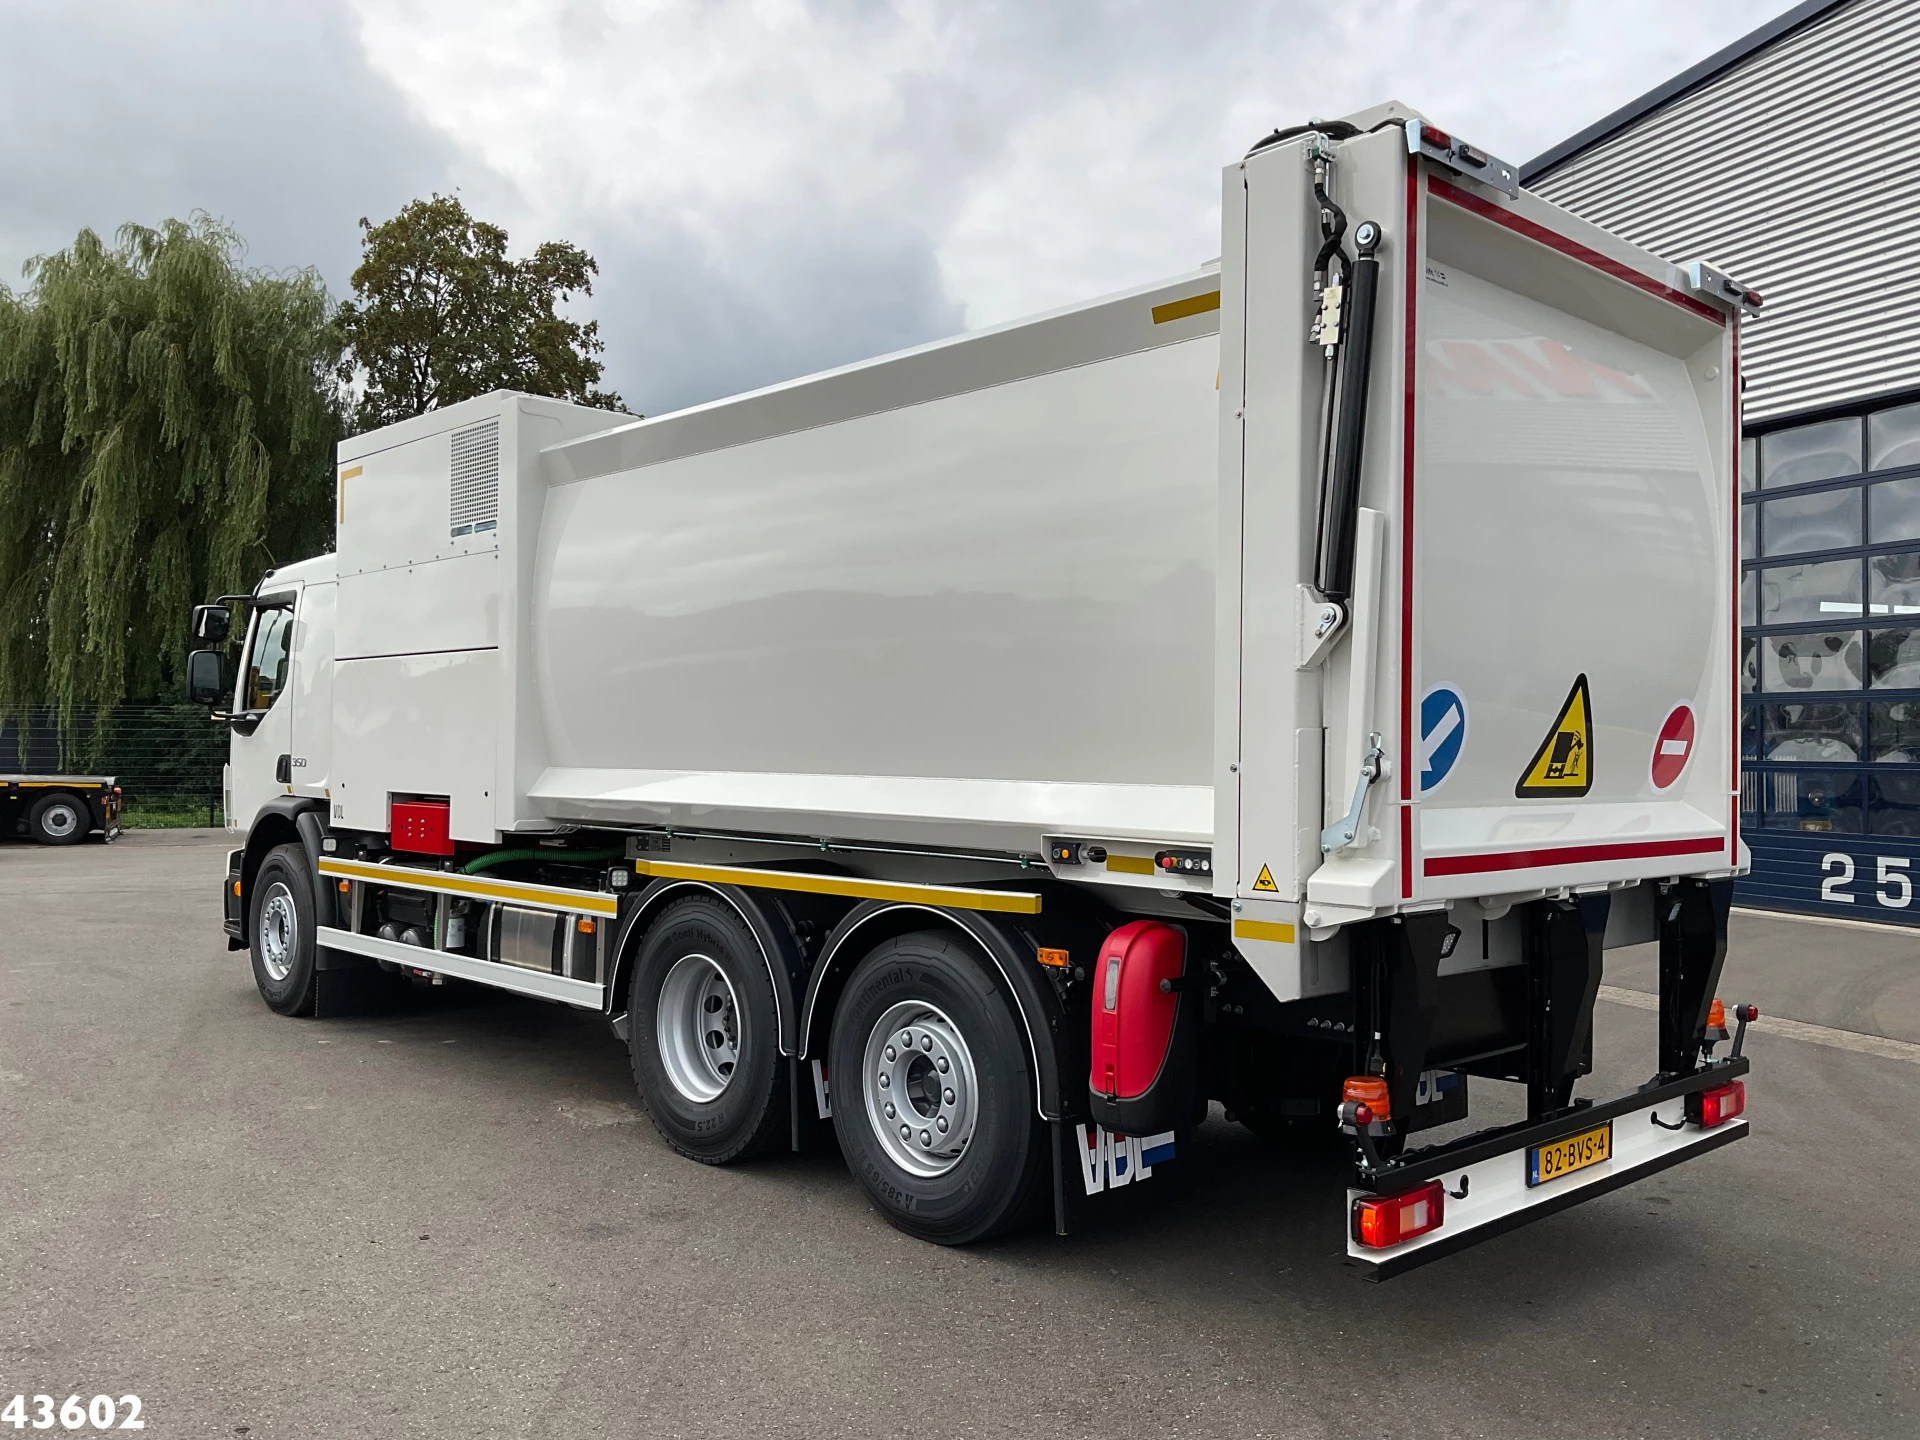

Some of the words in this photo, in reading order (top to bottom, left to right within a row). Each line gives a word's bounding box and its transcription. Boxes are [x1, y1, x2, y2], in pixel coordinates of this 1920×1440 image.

[292, 758, 307, 767] 350
[672, 928, 694, 943] Conti
[1416, 1070, 1443, 1106] DL
[697, 1116, 717, 1132] 22.5
[1076, 1123, 1152, 1195] VDL
[1545, 1132, 1605, 1174] 82-BVS-4
